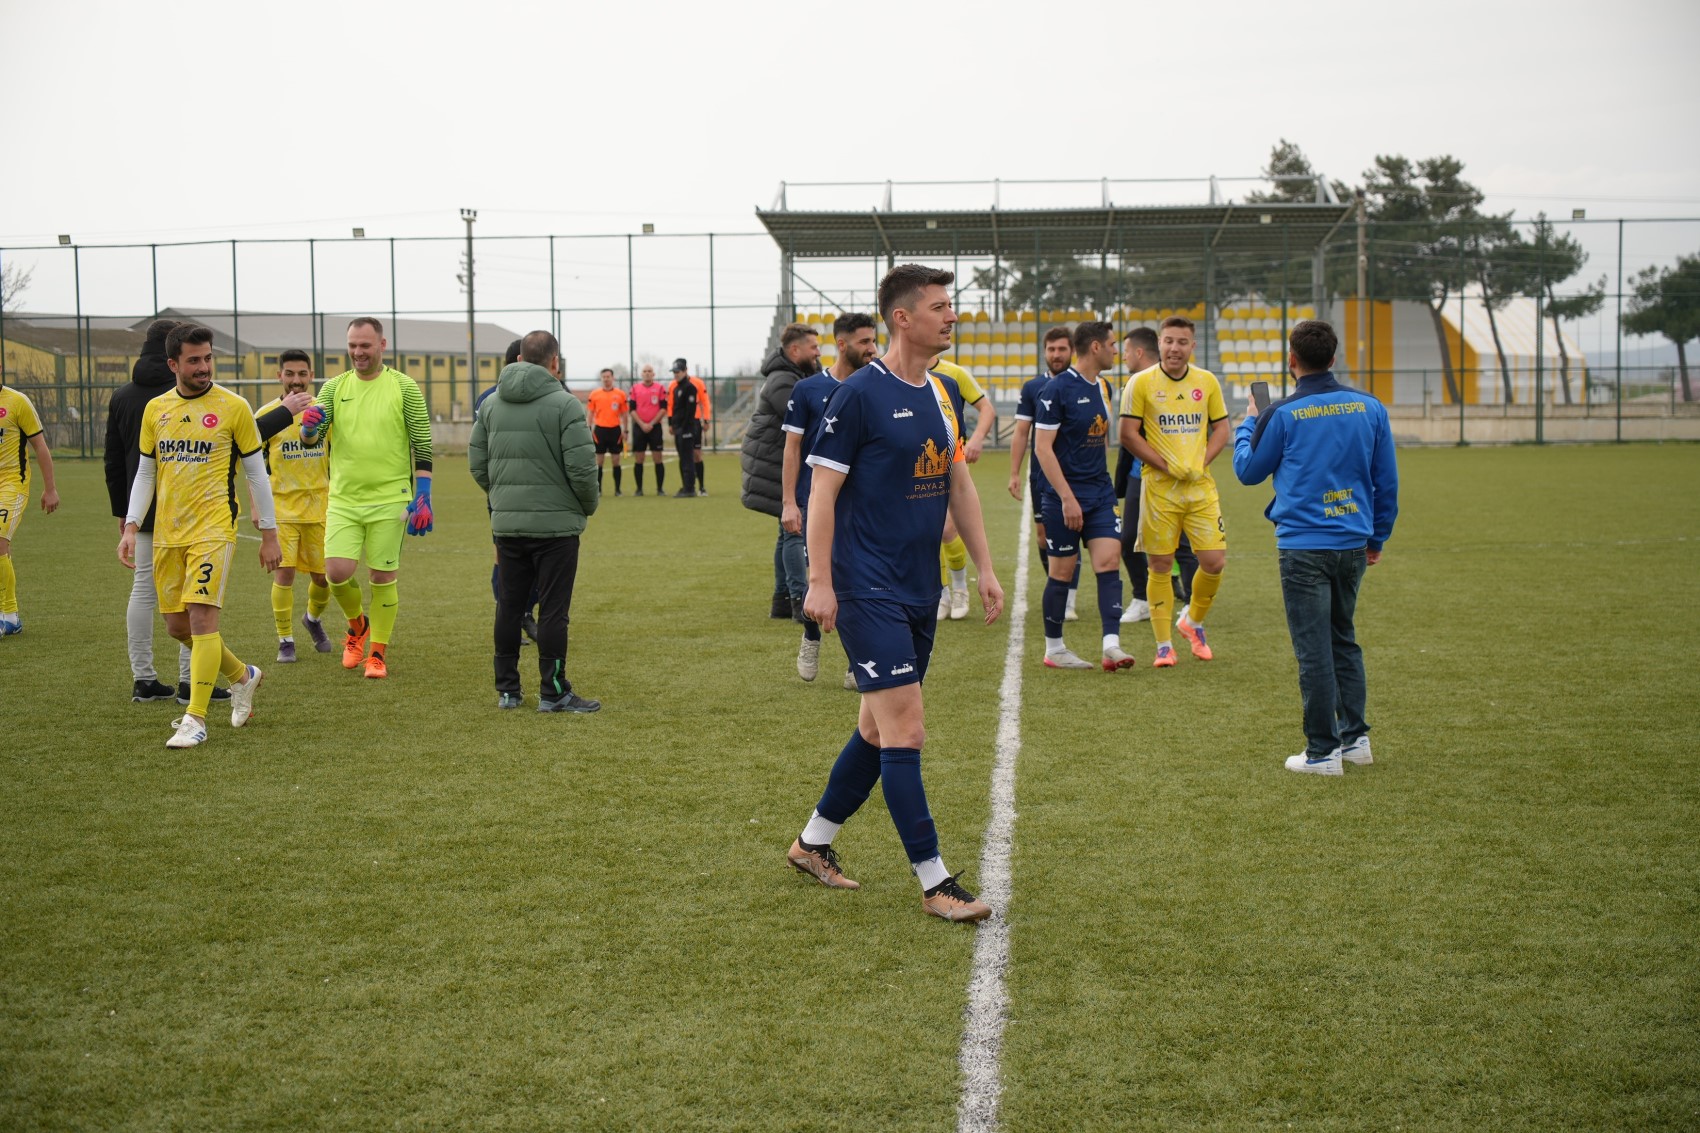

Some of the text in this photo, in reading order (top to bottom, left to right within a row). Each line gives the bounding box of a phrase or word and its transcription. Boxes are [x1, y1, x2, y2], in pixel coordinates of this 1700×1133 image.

[1159, 414, 1202, 425] AKALIN
[159, 439, 212, 455] AKALIN
[1323, 489, 1353, 504] CÖMERT
[197, 563, 213, 584] 3
